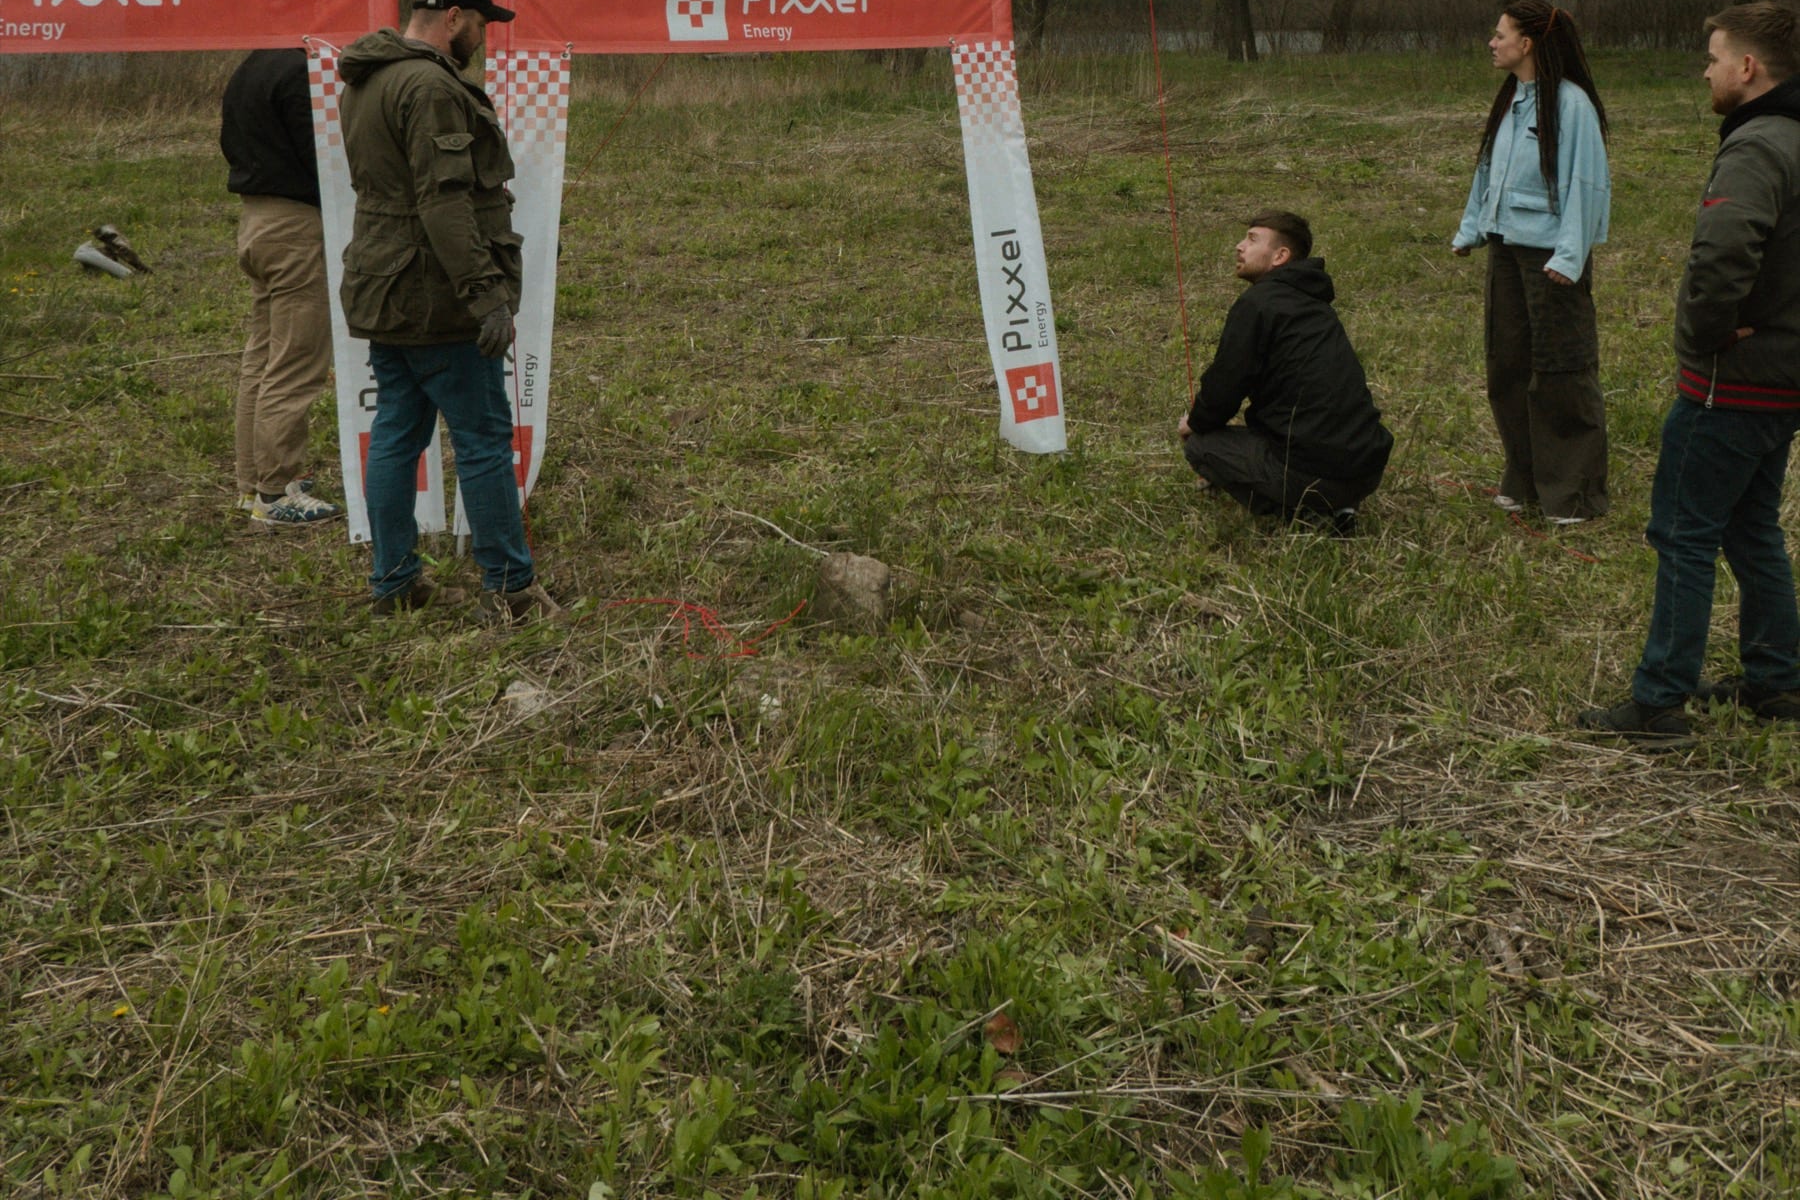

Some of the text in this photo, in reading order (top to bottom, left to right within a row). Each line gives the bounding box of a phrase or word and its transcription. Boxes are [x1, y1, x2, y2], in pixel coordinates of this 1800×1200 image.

[743, 24, 792, 41] Energy
[991, 228, 1032, 352] Pixxel
[1035, 301, 1048, 348] Energy
[520, 353, 538, 408] Energy
